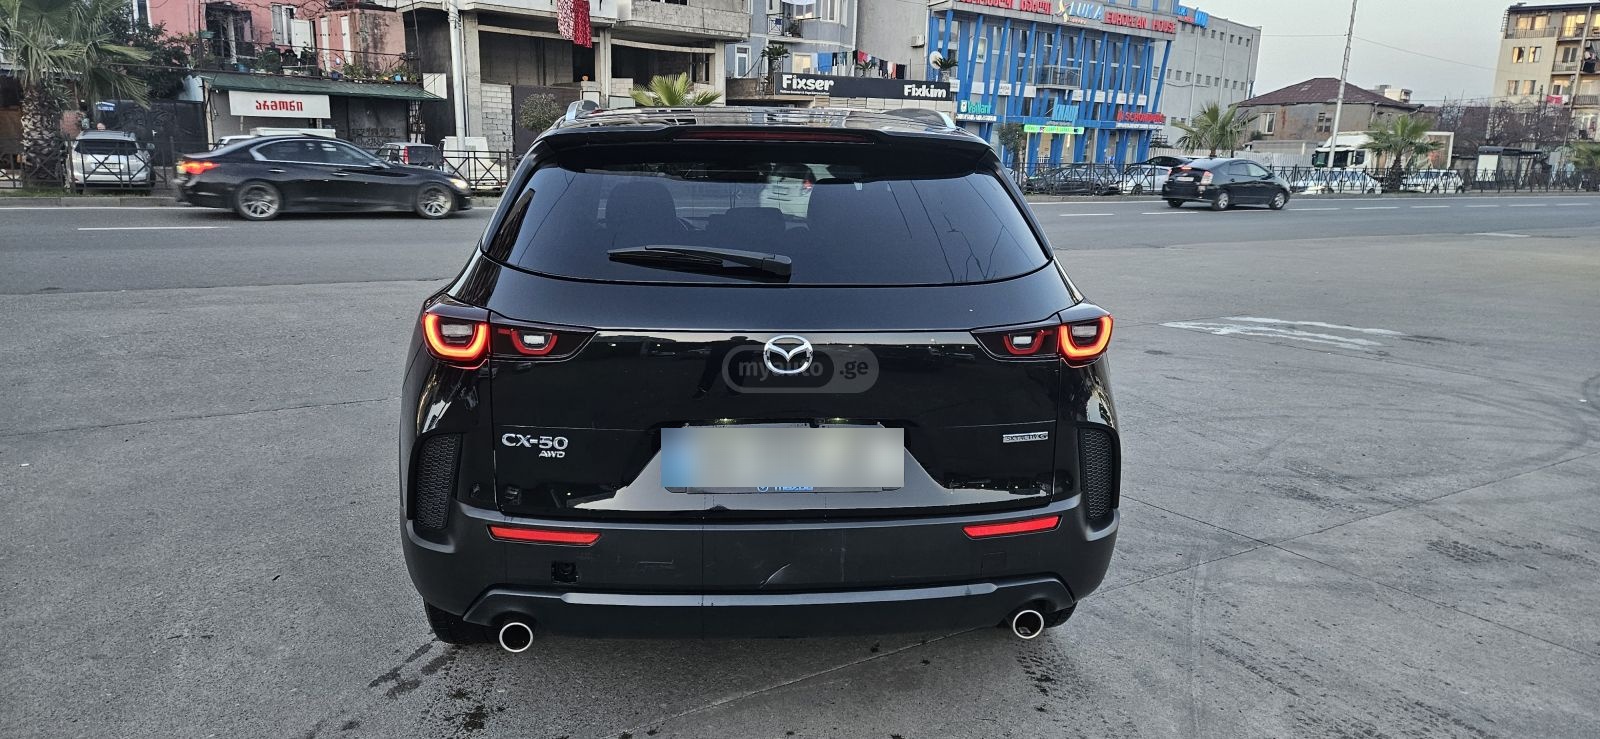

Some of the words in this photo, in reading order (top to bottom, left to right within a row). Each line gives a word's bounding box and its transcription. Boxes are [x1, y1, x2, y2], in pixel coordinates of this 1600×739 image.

[1069, 1, 1104, 20] LUKA
[1105, 11, 1147, 29] EUROPEAN
[1152, 19, 1176, 33] HOUSE
[782, 74, 834, 91] Fixser
[903, 84, 947, 98] Fixkim
[255, 100, 303, 111] არმონი
[501, 433, 569, 450] CX-50
[539, 450, 566, 458] AWD
